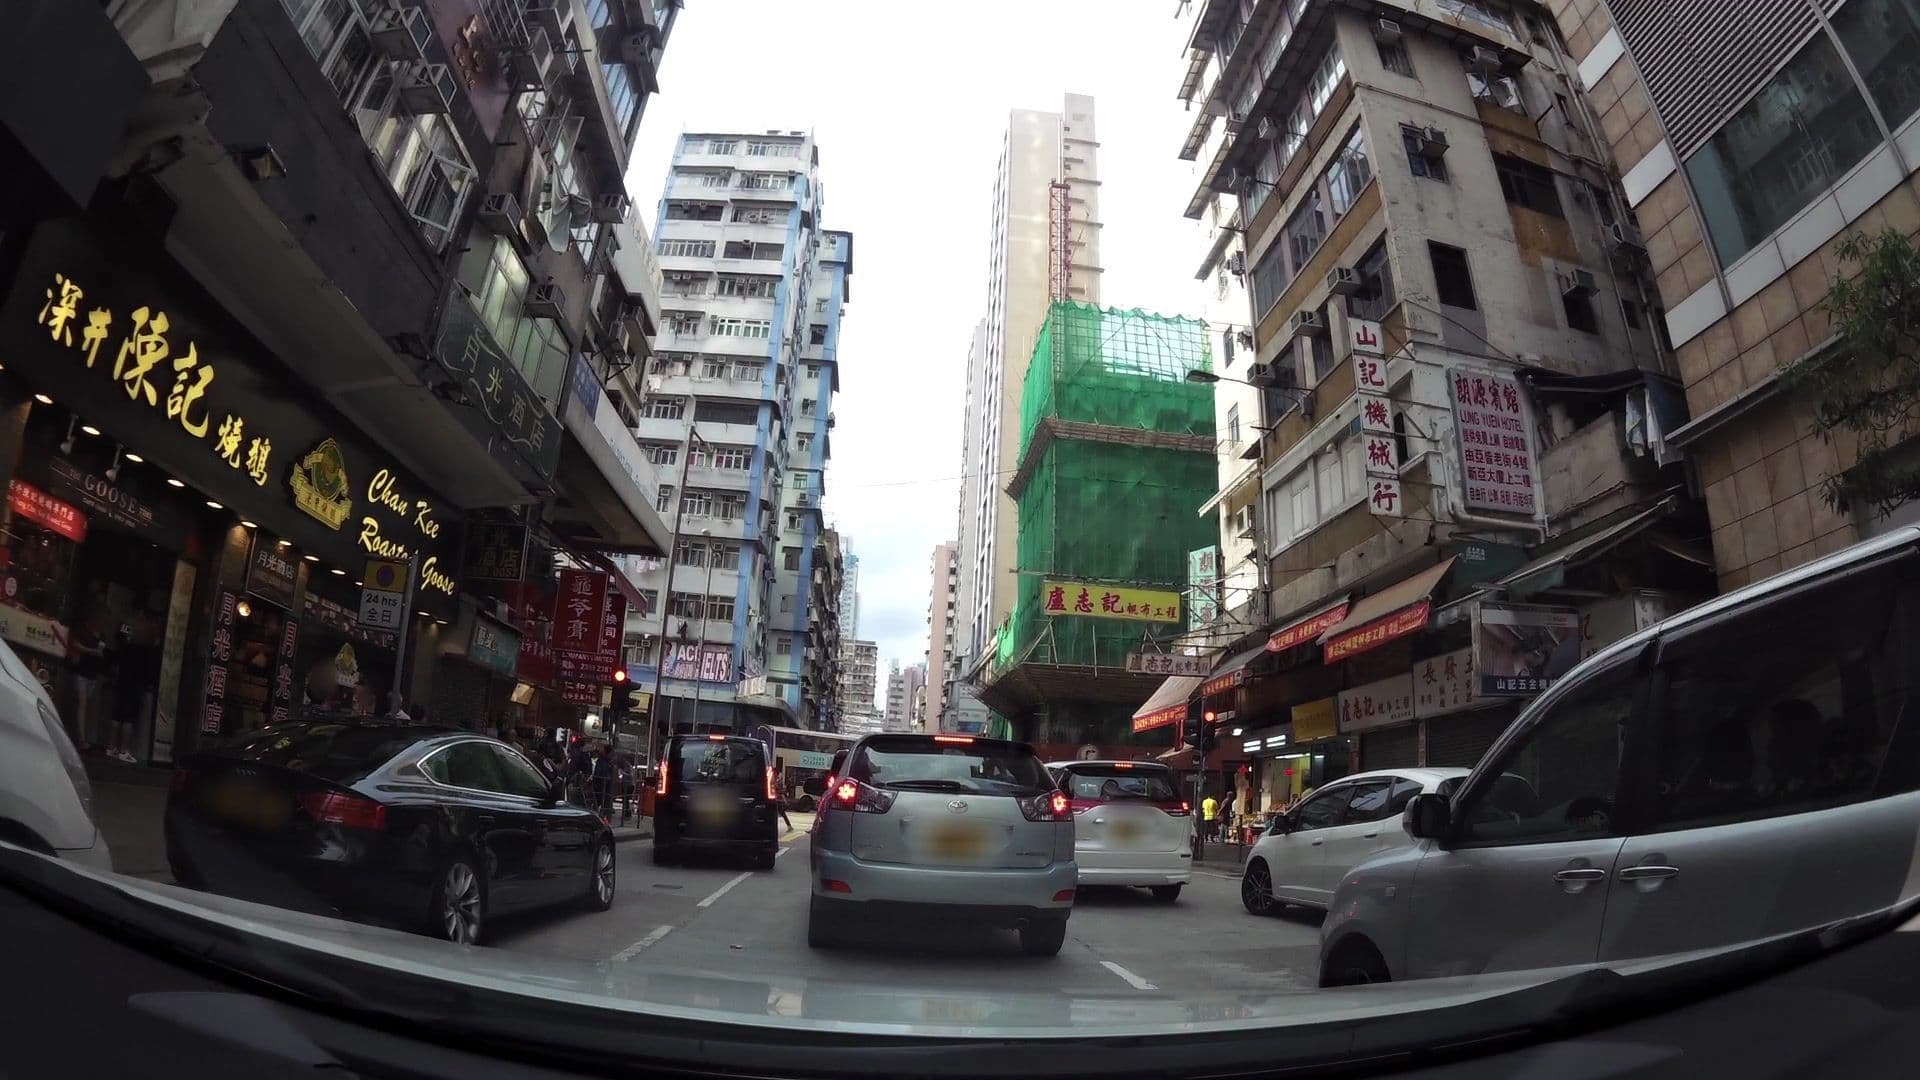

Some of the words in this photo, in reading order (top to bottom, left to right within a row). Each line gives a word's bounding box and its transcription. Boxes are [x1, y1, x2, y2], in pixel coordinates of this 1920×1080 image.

[1356, 325, 1398, 511] 山記機械行
[1460, 410, 1480, 425] LUNG
[1482, 412, 1501, 428] YUEN
[1501, 414, 1525, 433] HOTEL
[84, 473, 139, 514] GOOSE
[367, 468, 409, 517] Chan
[414, 500, 440, 539] Kee
[357, 516, 410, 560] Roast
[256, 550, 296, 580] 月光酒店
[420, 555, 456, 596] Goose
[366, 593, 379, 604] 24
[381, 595, 398, 608] hrs
[366, 608, 393, 623] 全日
[701, 652, 728, 681] IELTS
